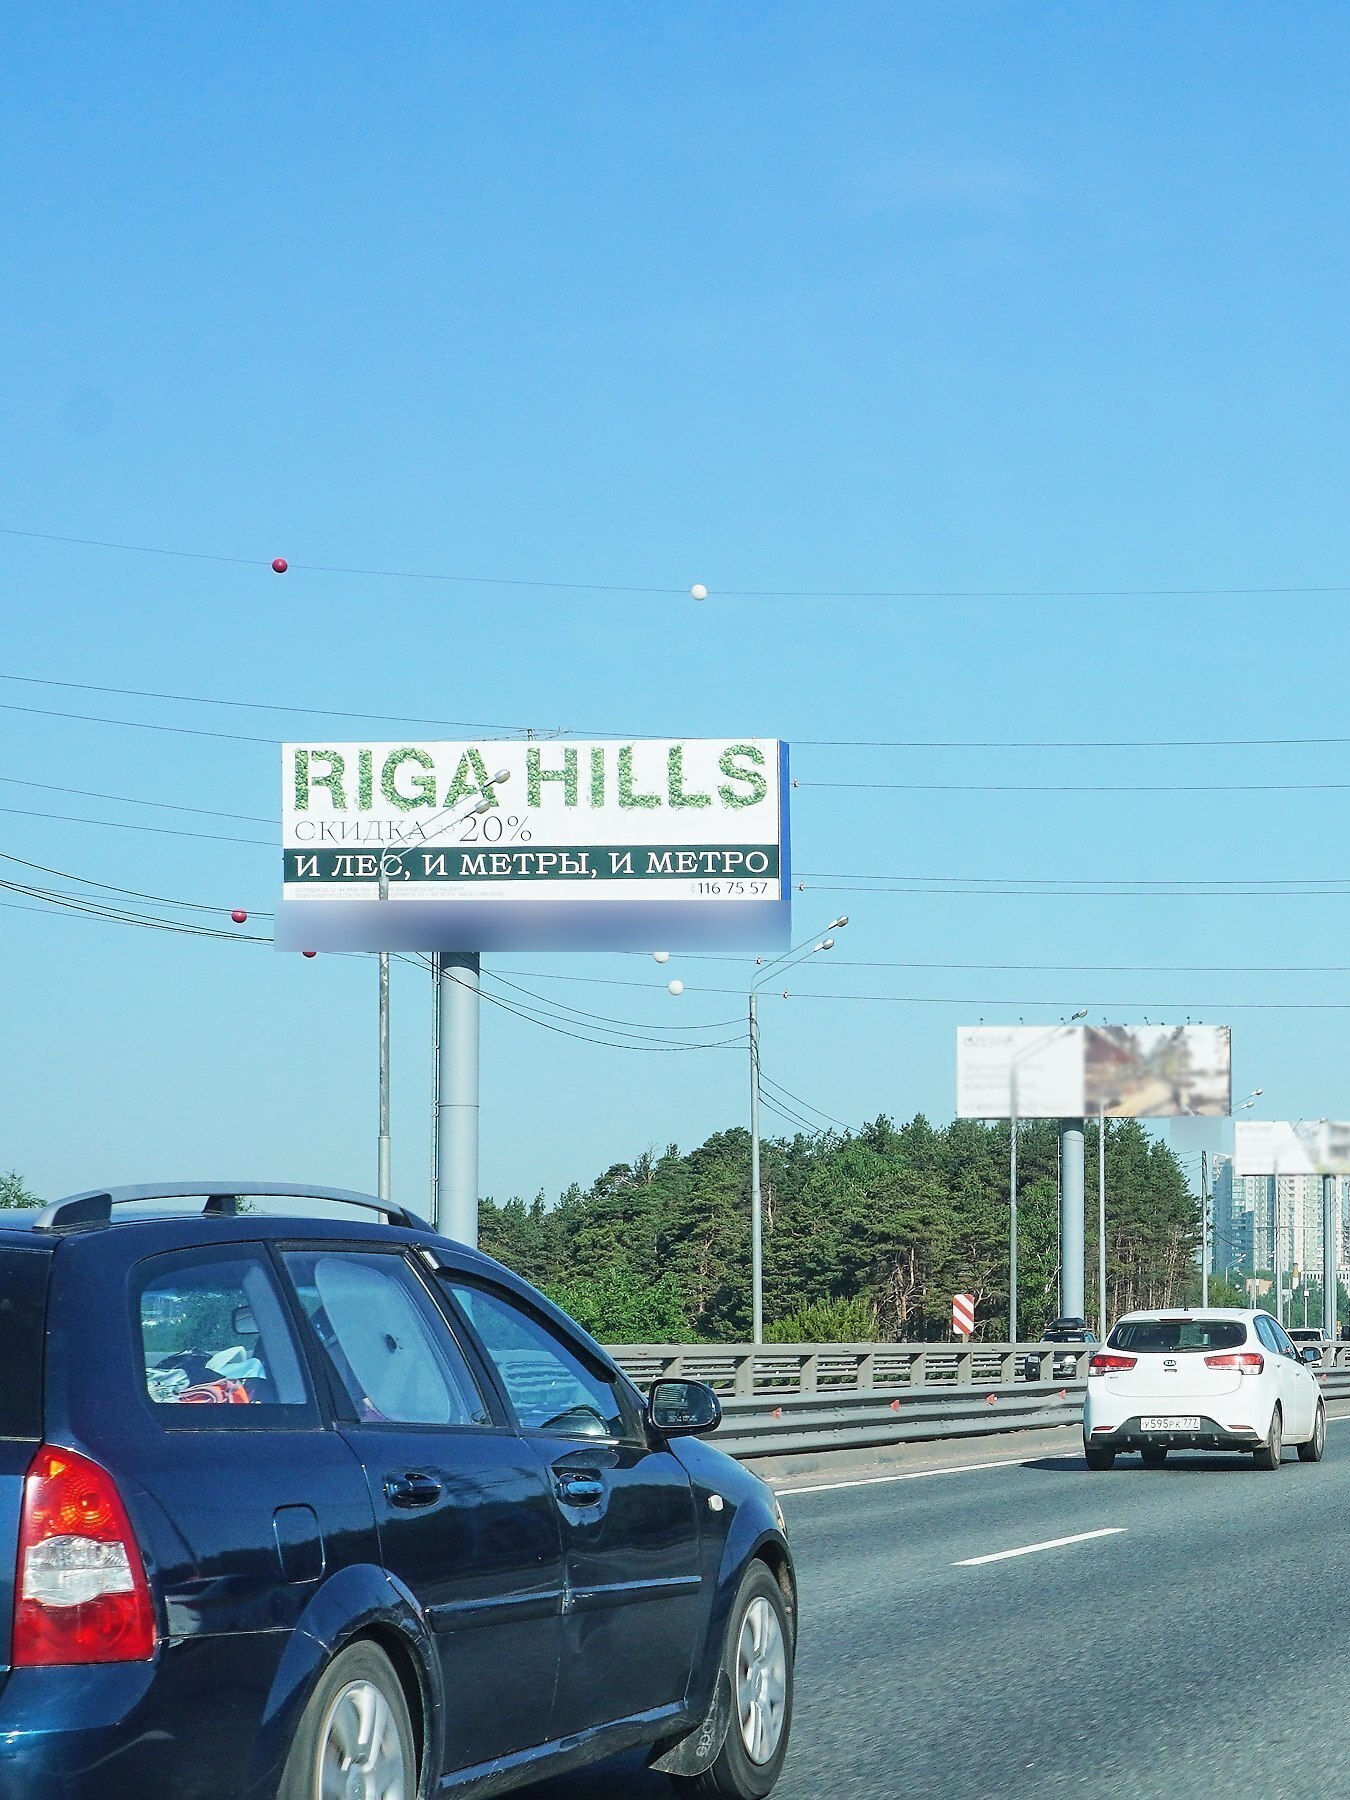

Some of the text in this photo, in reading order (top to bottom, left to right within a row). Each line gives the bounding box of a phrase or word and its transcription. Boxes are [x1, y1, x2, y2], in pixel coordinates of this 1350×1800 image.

[293, 743, 769, 812] RIGA HILLS
[294, 820, 429, 845] СКИДКА
[459, 814, 533, 842] 20%
[294, 850, 769, 881] И ЛЕС, И МЕТРЫ, И МЕТРО
[698, 882, 721, 894] 116
[726, 882, 744, 894] 75
[750, 881, 768, 894] 57
